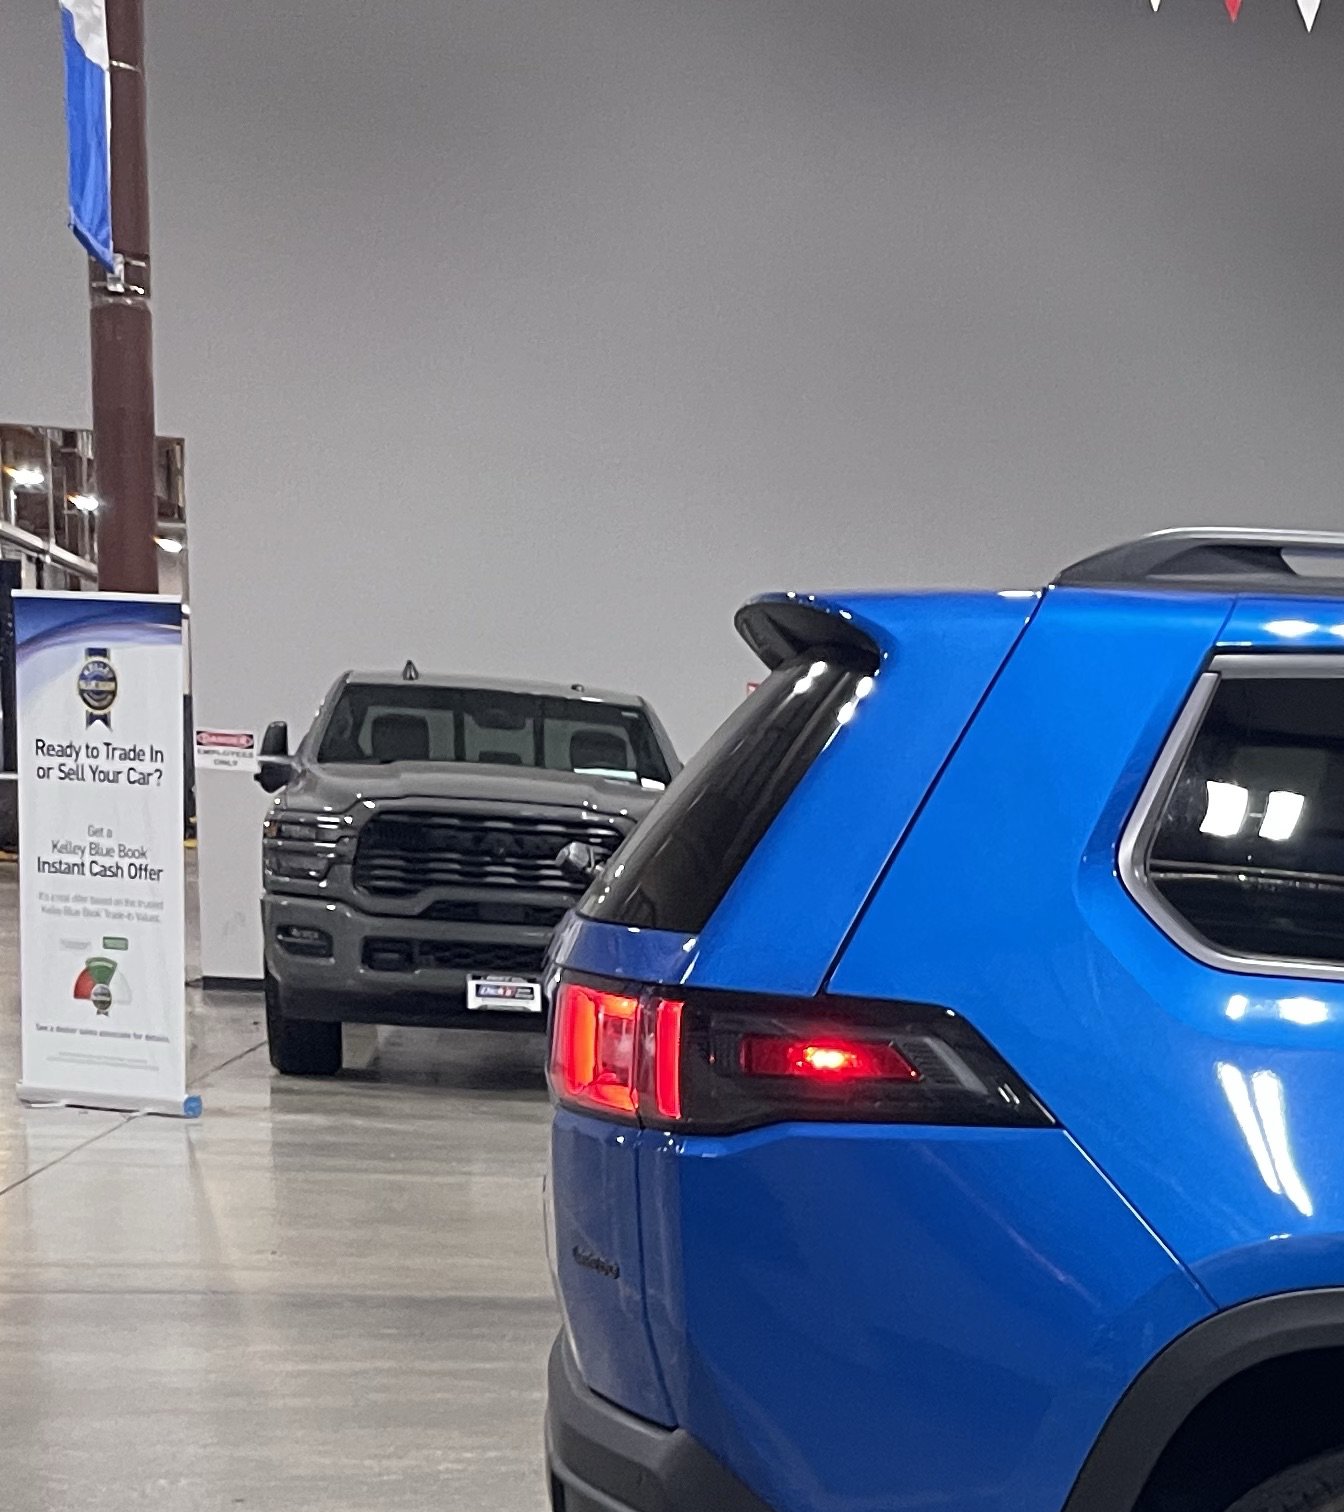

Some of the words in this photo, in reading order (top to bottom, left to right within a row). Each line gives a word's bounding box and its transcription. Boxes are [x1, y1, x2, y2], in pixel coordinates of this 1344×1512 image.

[35, 738, 81, 762] Ready
[85, 742, 100, 759] to
[103, 742, 145, 762] Trade
[150, 744, 164, 763] In
[37, 765, 54, 779] or
[58, 763, 86, 782] Sell
[89, 764, 123, 784] Your
[127, 767, 163, 786] Car?
[87, 824, 104, 838] Get
[107, 828, 112, 838] a
[51, 839, 86, 858] Kelley
[89, 841, 116, 858] Blue
[118, 843, 148, 859] Book
[37, 857, 85, 876] Instant
[89, 860, 124, 878] Cash
[128, 863, 164, 881] Offer
